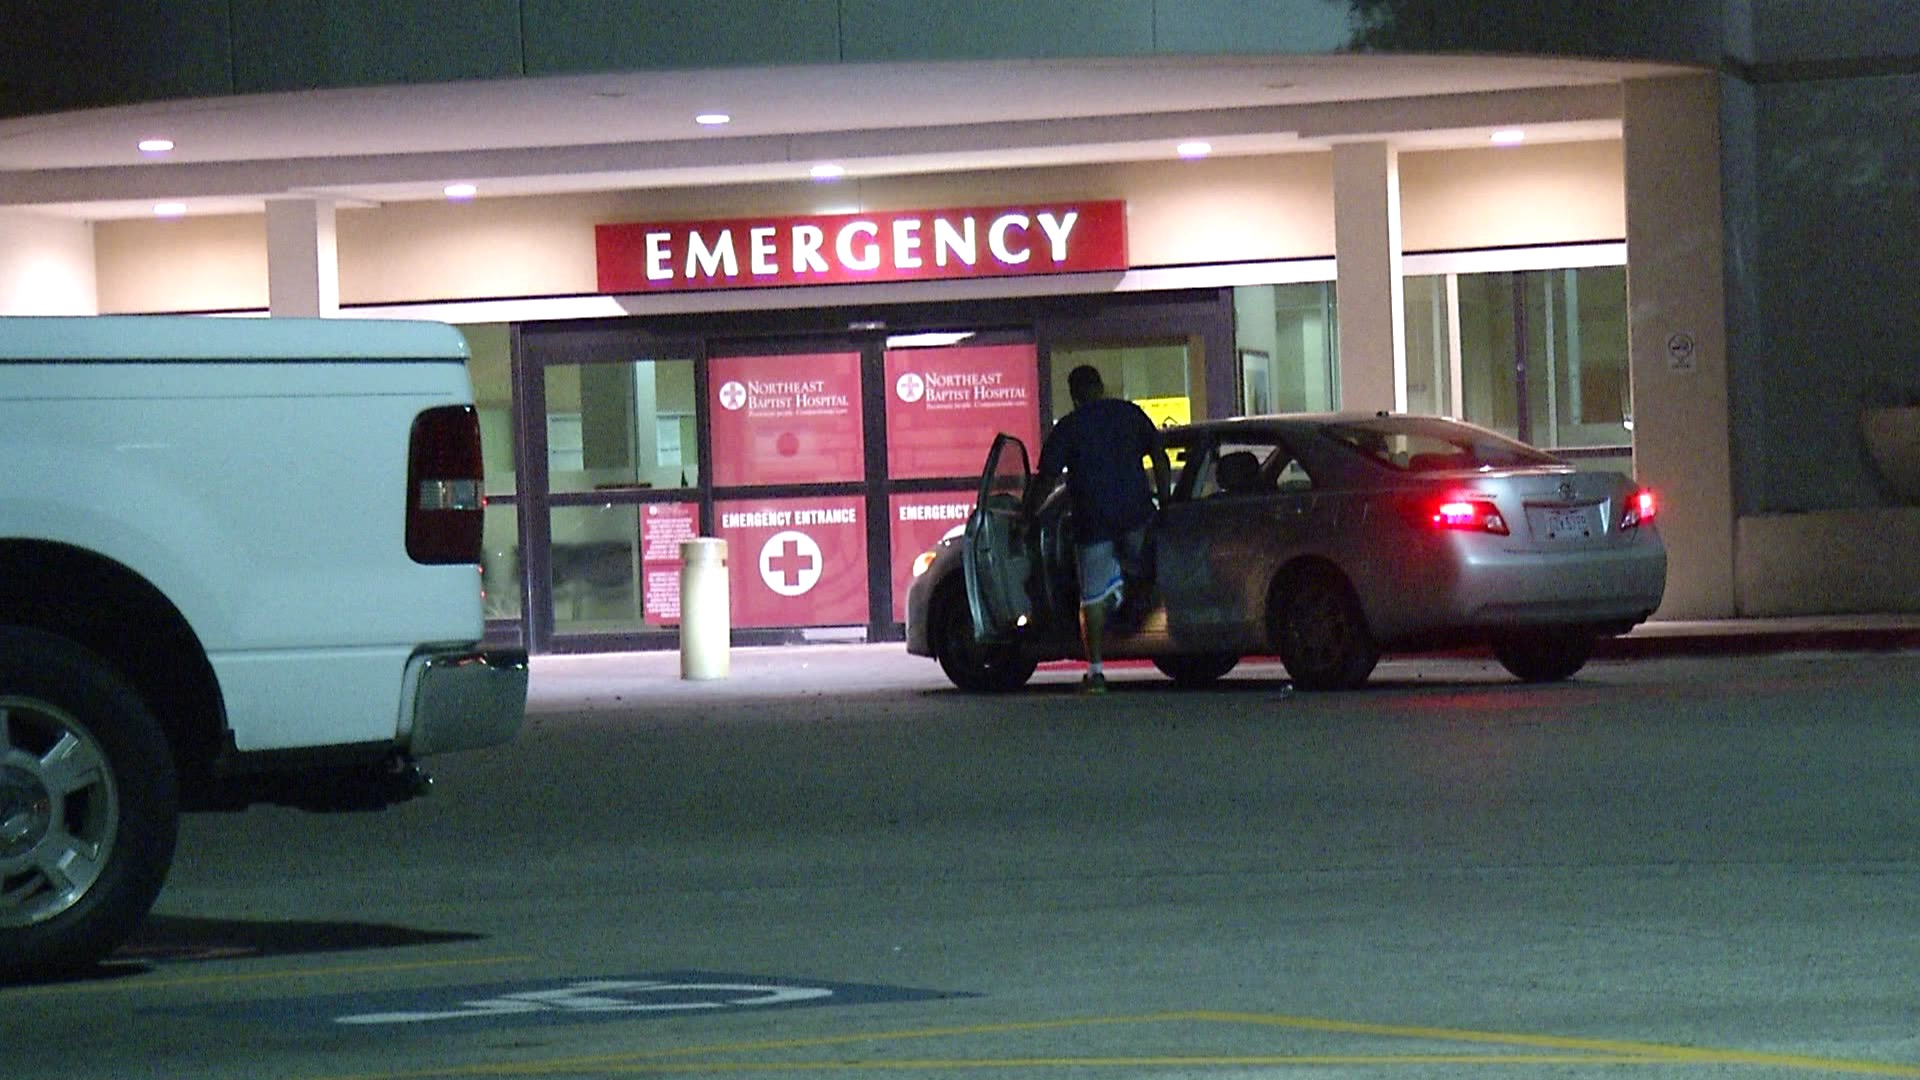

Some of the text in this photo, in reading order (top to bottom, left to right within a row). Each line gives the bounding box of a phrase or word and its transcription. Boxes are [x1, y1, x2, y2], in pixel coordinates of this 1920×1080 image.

[645, 211, 1079, 281] EMERGENCY
[747, 380, 825, 395] NORTHEAST
[925, 372, 1003, 387] NORTHEAST
[748, 393, 849, 409] BAPTIST HOSPITAL
[925, 385, 1027, 402] BAPTIST HOSPITAL
[721, 507, 857, 529] EMERGENCY ENTRANCE
[899, 504, 969, 521] EMERGENCY
